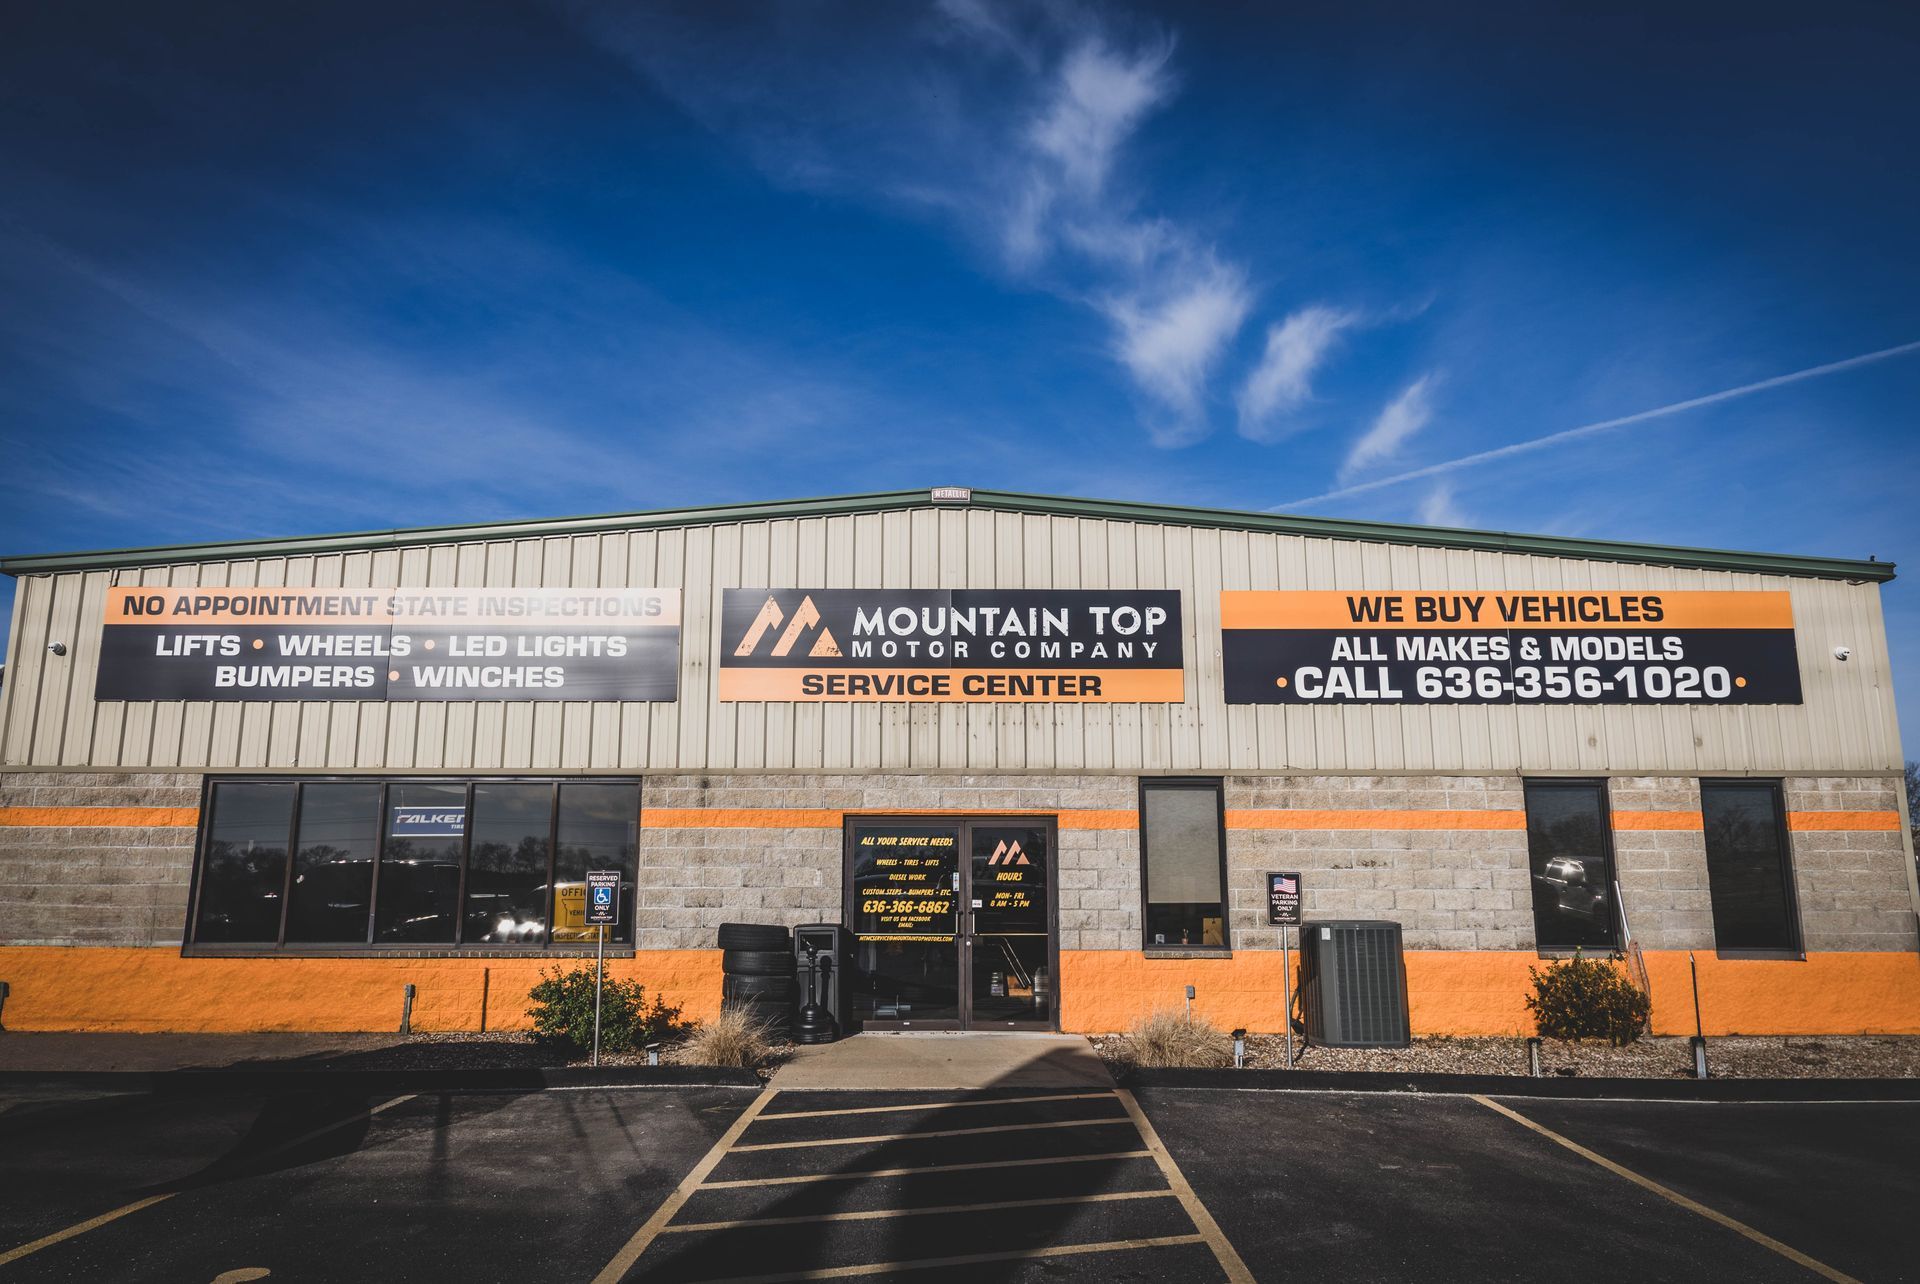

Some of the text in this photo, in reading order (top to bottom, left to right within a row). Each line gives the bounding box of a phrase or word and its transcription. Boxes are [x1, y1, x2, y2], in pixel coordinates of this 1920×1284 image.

[123, 596, 662, 616] NO APPOINTMENT STATE INSPECTIONS
[1346, 596, 1664, 622] WE BUY VEHICLES
[852, 606, 1167, 636] MOUNTAIN TOP
[156, 635, 628, 656] LIFTS WHEELS LED LIGHTS
[852, 641, 1158, 658] MOTOR COMPANY
[1331, 636, 1684, 661] ALL MAKES & MODELS
[215, 666, 564, 688] BUMPERS WINCHES
[802, 674, 1102, 696] SERVICE CENTER
[1294, 666, 1732, 698] CALL 636-356-1020
[860, 836, 954, 846] ALL YOUR SERVICE NEEDS
[996, 872, 1023, 881] HOURS
[863, 900, 950, 914] 636-366-6862
